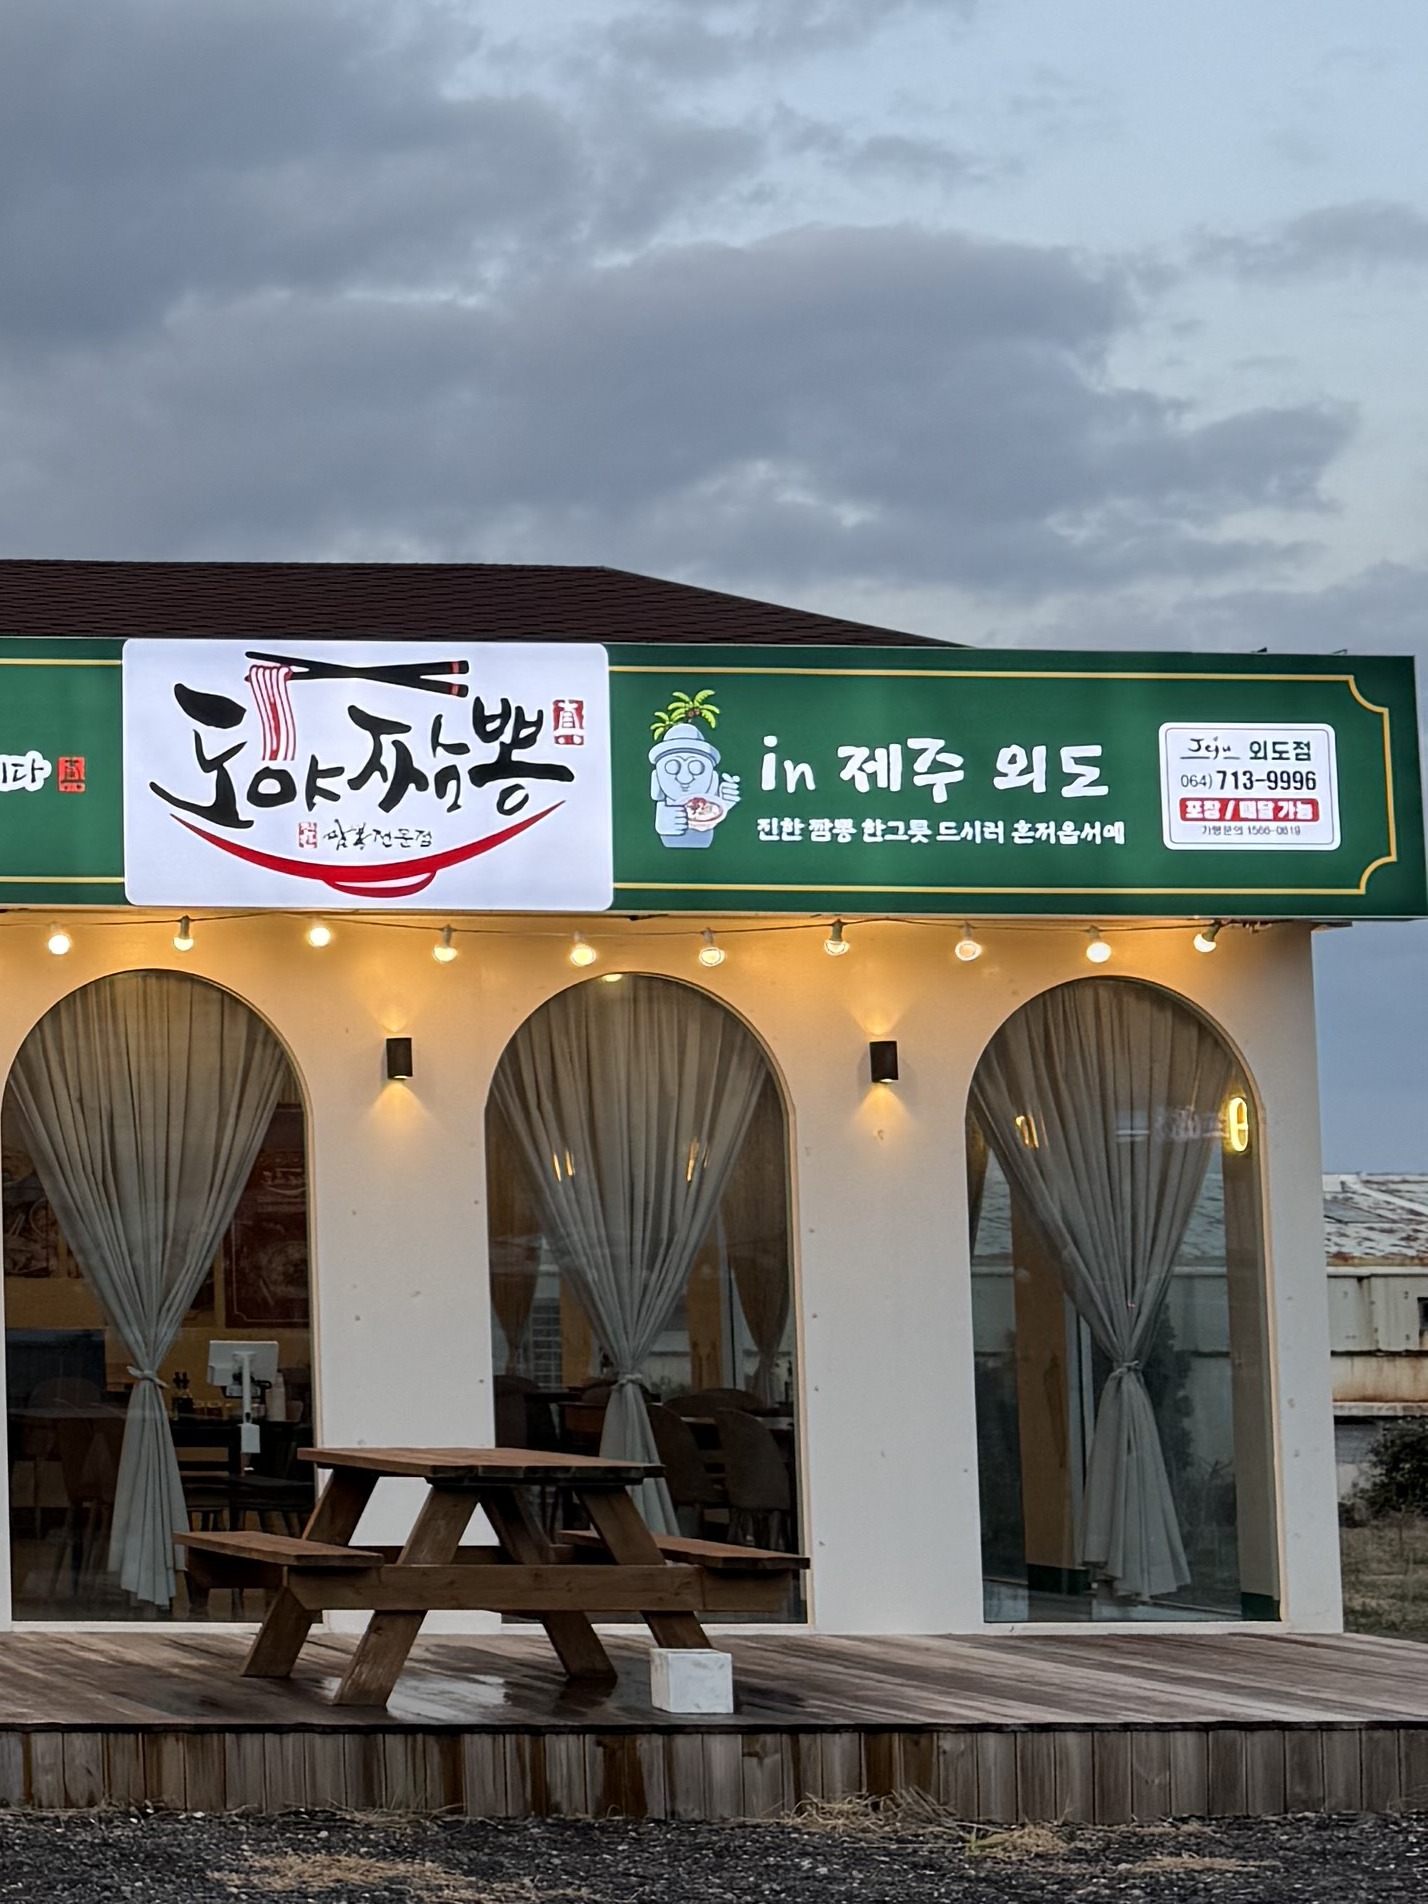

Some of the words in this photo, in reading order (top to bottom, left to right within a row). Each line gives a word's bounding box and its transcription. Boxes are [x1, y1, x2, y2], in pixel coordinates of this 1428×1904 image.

[148, 683, 575, 829] 도야짬뽕
[760, 735, 817, 794] in
[837, 737, 965, 804] 제주
[993, 744, 1110, 798] 외도
[1187, 736, 1232, 760] Jeju
[1249, 740, 1312, 762] 외도점
[757, 818, 805, 842] 진한
[808, 818, 857, 843] 짬뽕
[861, 818, 932, 844] 한그릇
[936, 821, 1005, 844] 드시러
